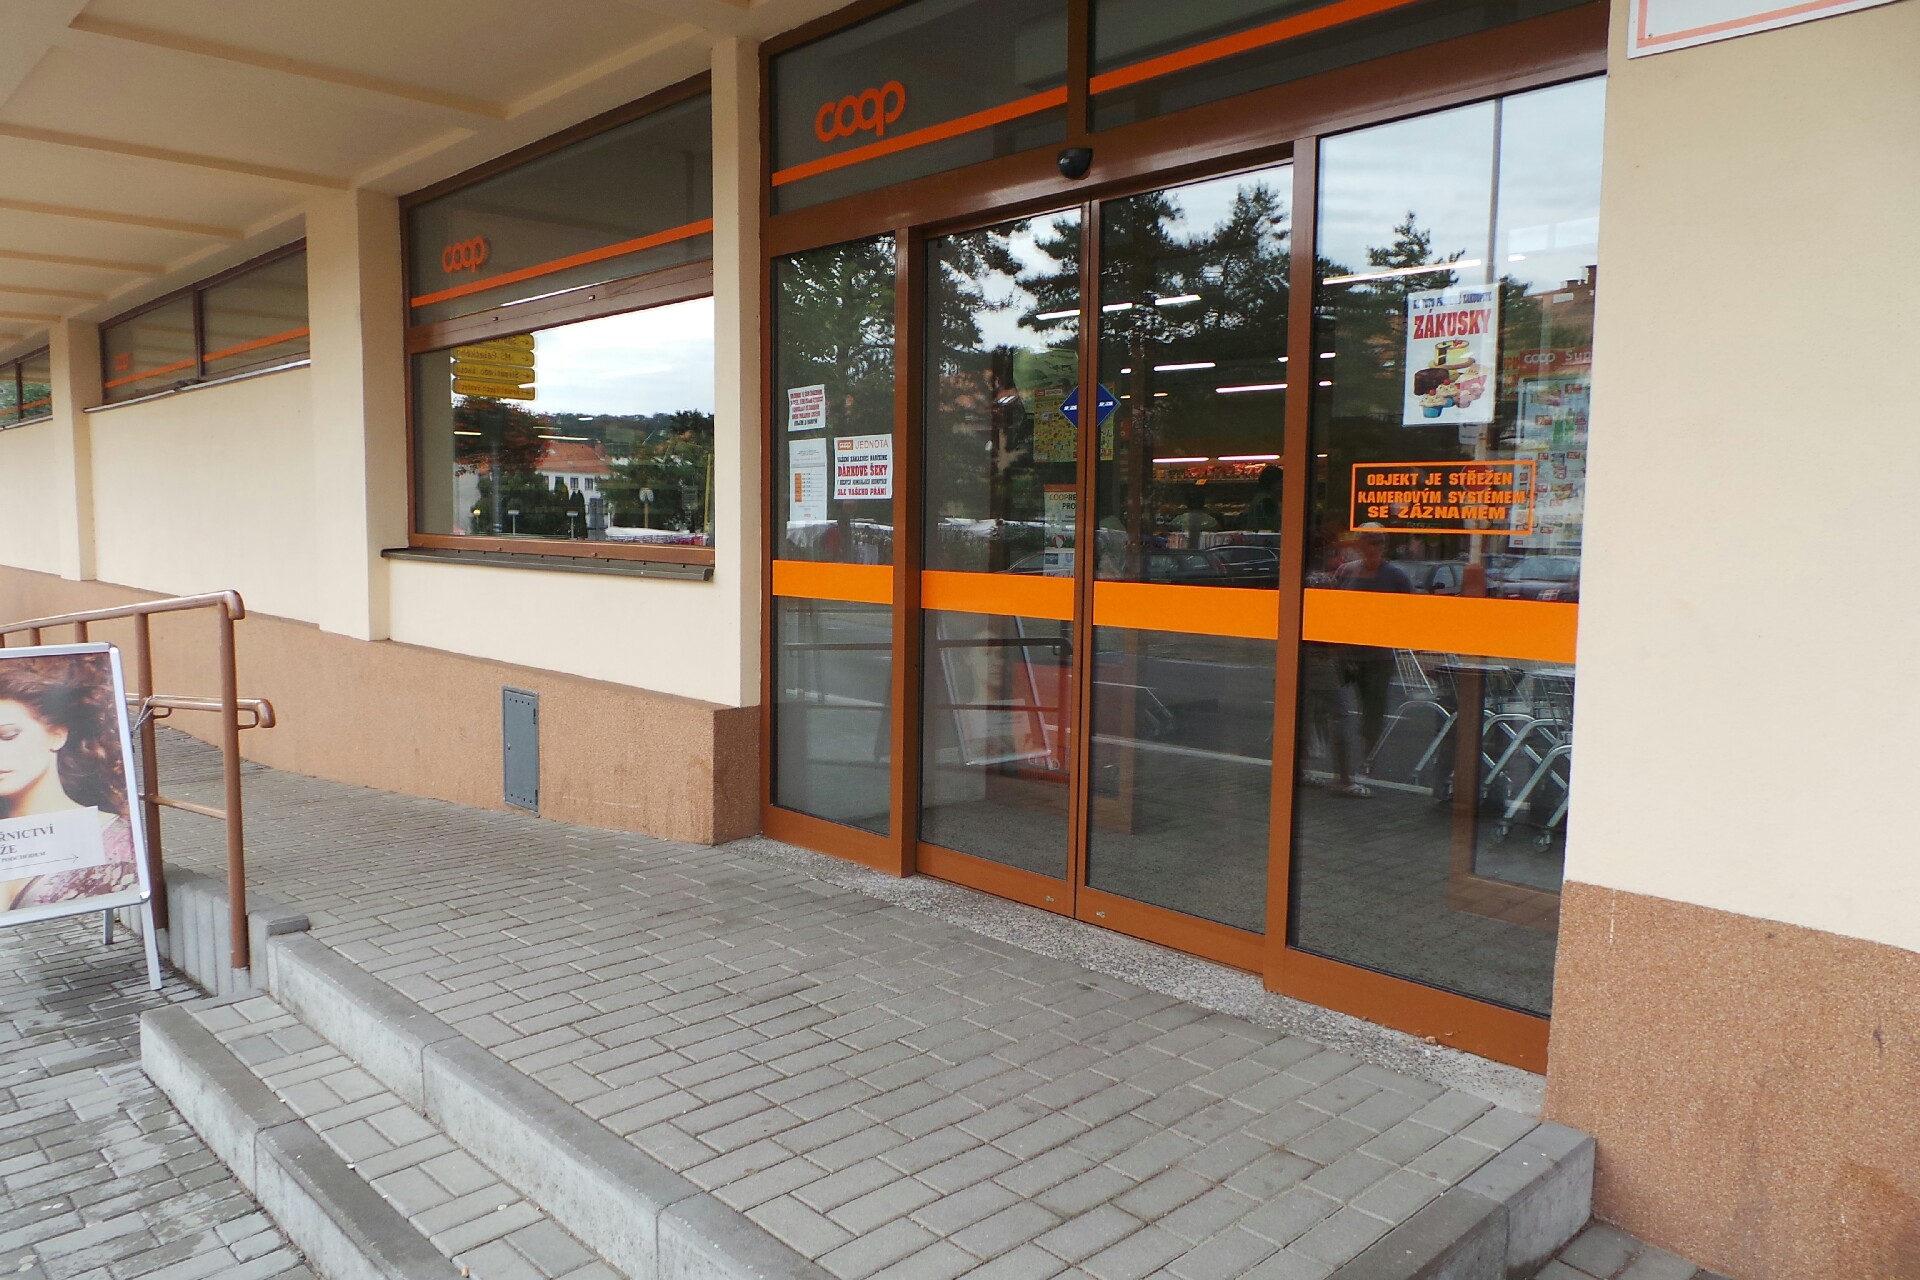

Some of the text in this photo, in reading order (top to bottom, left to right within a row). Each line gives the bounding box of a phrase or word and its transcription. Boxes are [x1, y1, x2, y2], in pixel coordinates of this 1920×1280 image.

[815, 80, 906, 143] coop
[442, 235, 487, 273] coop
[1413, 308, 1492, 339] ZÁKUSKY
[855, 439, 889, 450] JEDNOTA
[837, 462, 888, 478] DÁRKOVÉ ŠEKY
[1367, 470, 1513, 486] OBJEKT JE STŘEŽEN
[870, 486, 887, 496] PŘÁNÍ
[1358, 487, 1526, 504] KAMEROVÝM SYSTÉMEM
[1367, 503, 1507, 519] SE ZÁZNAMEM
